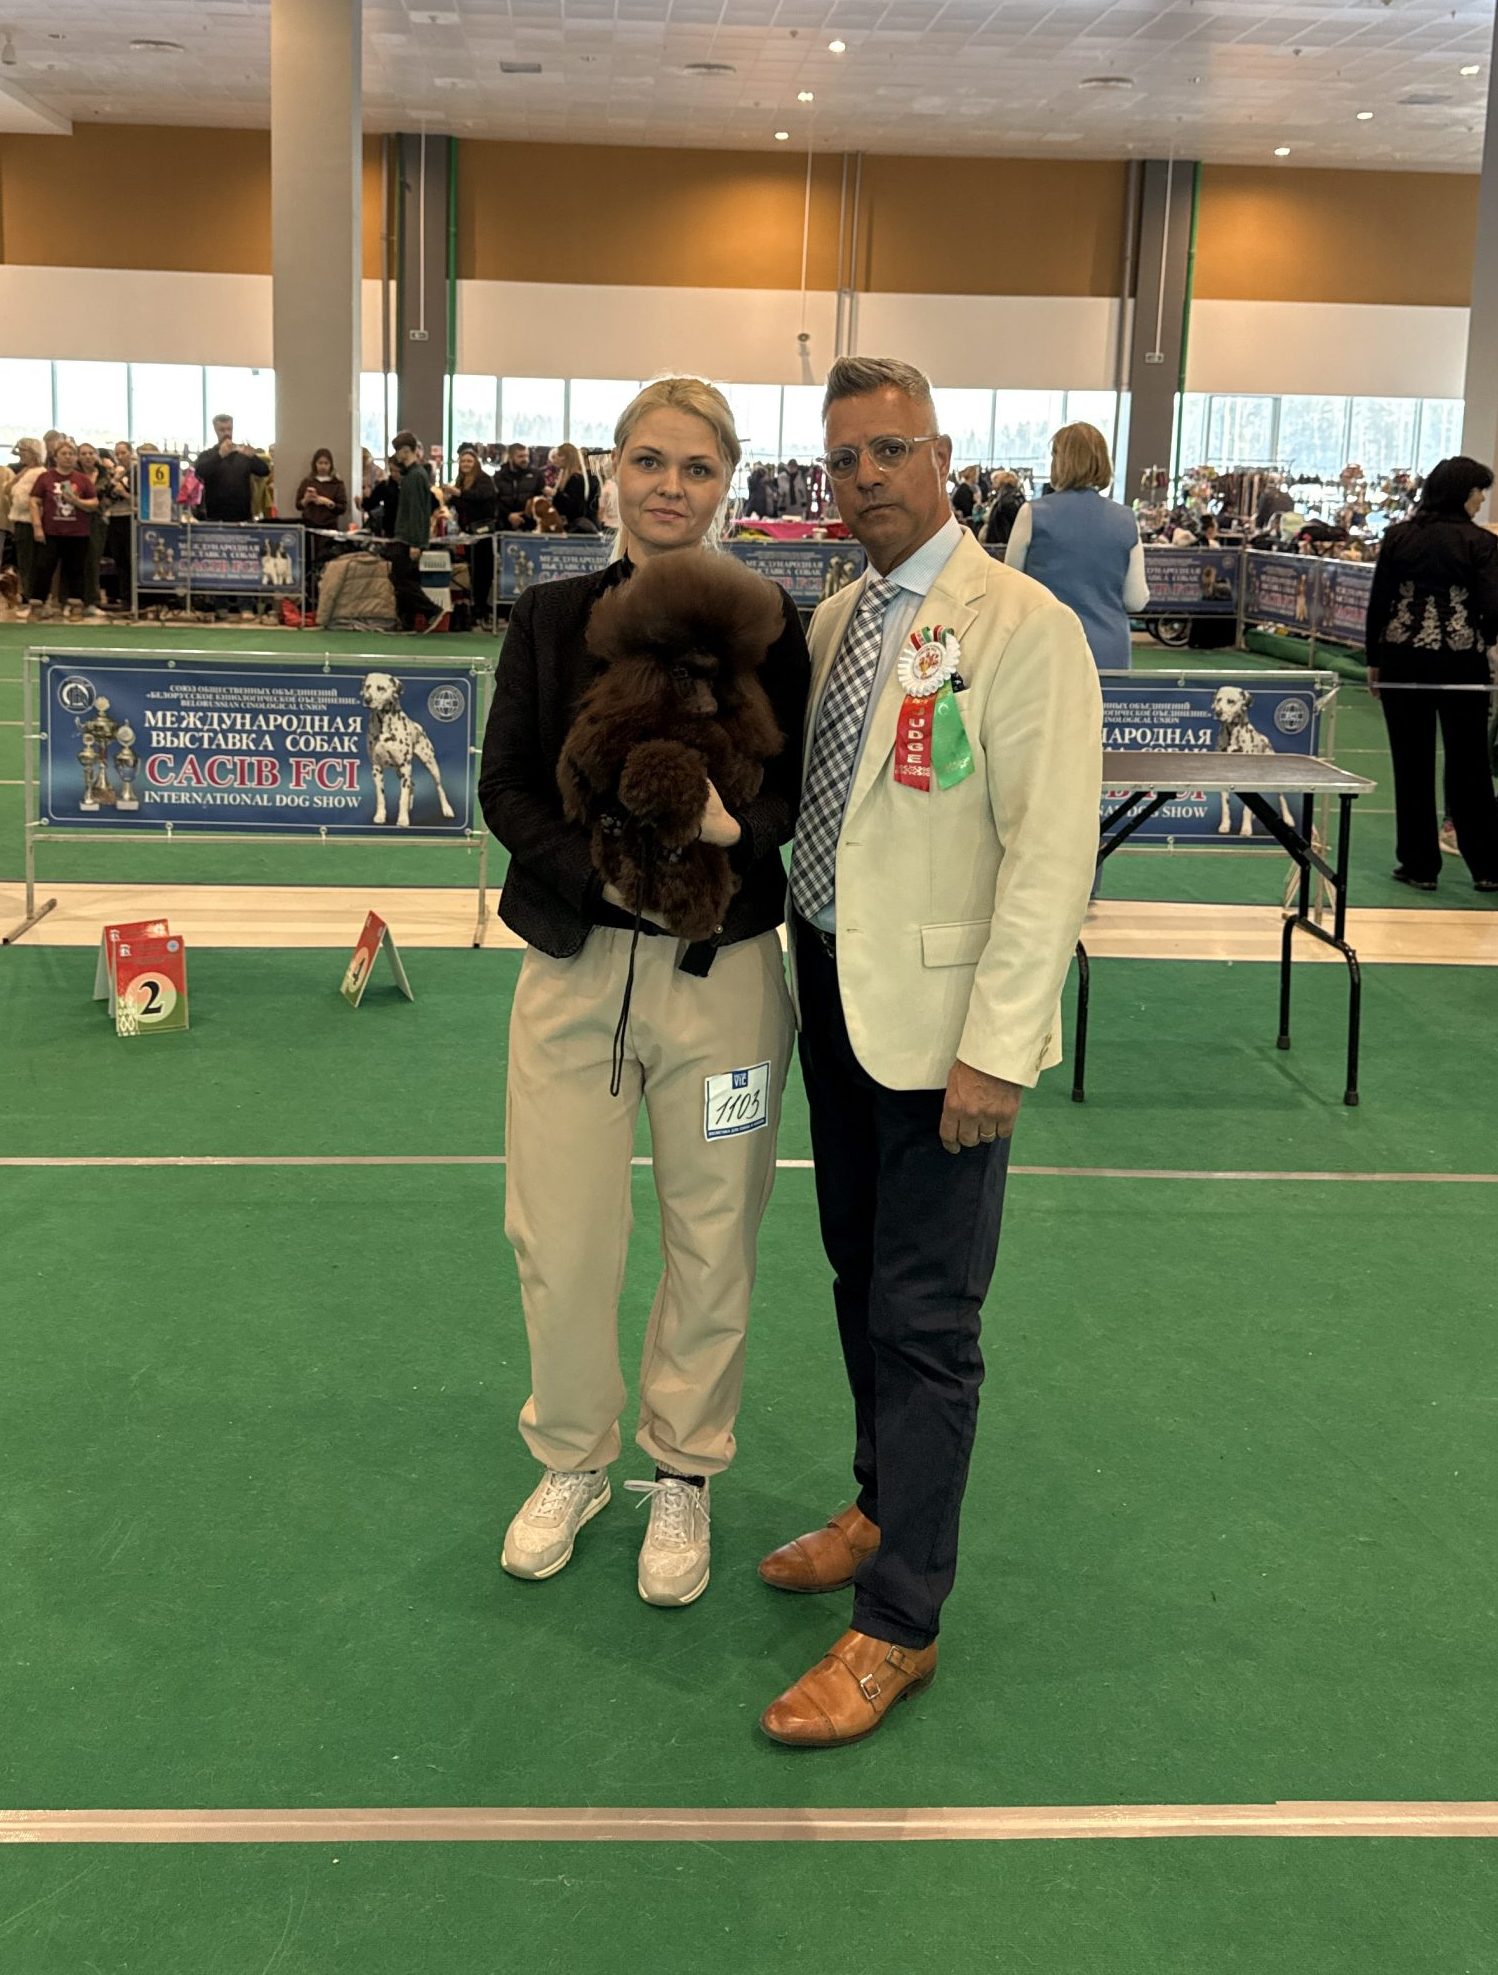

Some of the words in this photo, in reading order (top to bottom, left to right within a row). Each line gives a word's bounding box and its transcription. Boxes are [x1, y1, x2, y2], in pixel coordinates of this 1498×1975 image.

[155, 465, 164, 480] 6
[300, 703, 328, 711] UNION
[144, 710, 363, 733] МЕЖДУНАРОДНАЯ
[151, 731, 274, 750] ВЫСТАВКА
[285, 734, 359, 753] СОБАК
[145, 753, 281, 788] CACIB
[289, 757, 360, 791] FCI
[144, 791, 272, 806] INTERNATIONAL
[276, 794, 310, 807] DOG
[313, 795, 362, 808] SHOW
[1162, 806, 1208, 818] SHOW
[139, 980, 163, 1015] 2
[716, 1089, 760, 1125] 1103
